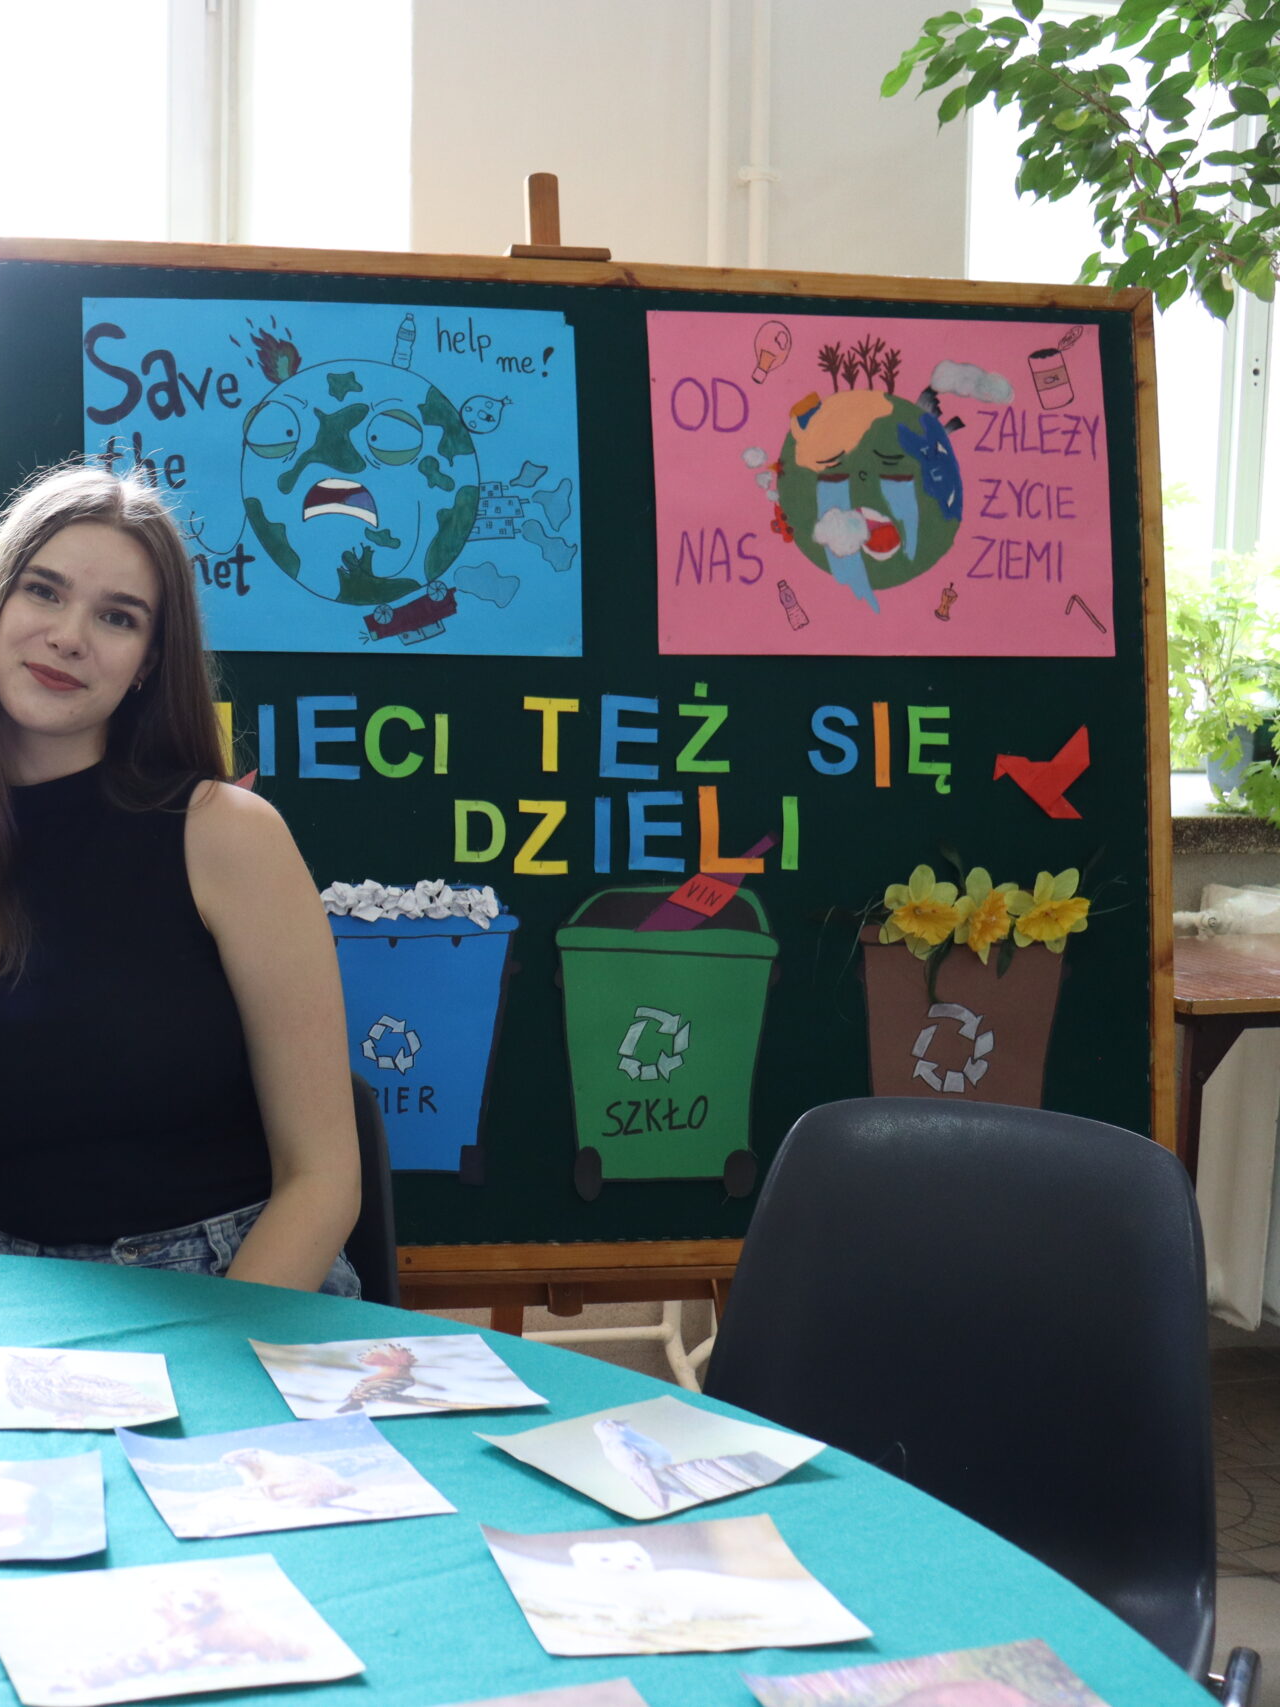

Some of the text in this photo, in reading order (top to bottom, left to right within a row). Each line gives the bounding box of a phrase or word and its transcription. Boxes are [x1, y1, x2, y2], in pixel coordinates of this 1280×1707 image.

[436, 316, 492, 363] help
[496, 346, 555, 378] me!
[84, 322, 242, 426] Save
[671, 377, 749, 433] OD
[97, 431, 187, 489] the
[190, 543, 256, 597] net
[675, 527, 764, 586] NAS
[966, 535, 1064, 583] ZIEMI
[212, 681, 952, 794] IECI TEŻ SIĘ
[454, 785, 799, 875] DZIELI
[687, 881, 722, 907] VIN
[601, 1095, 709, 1137] SZKŁO
